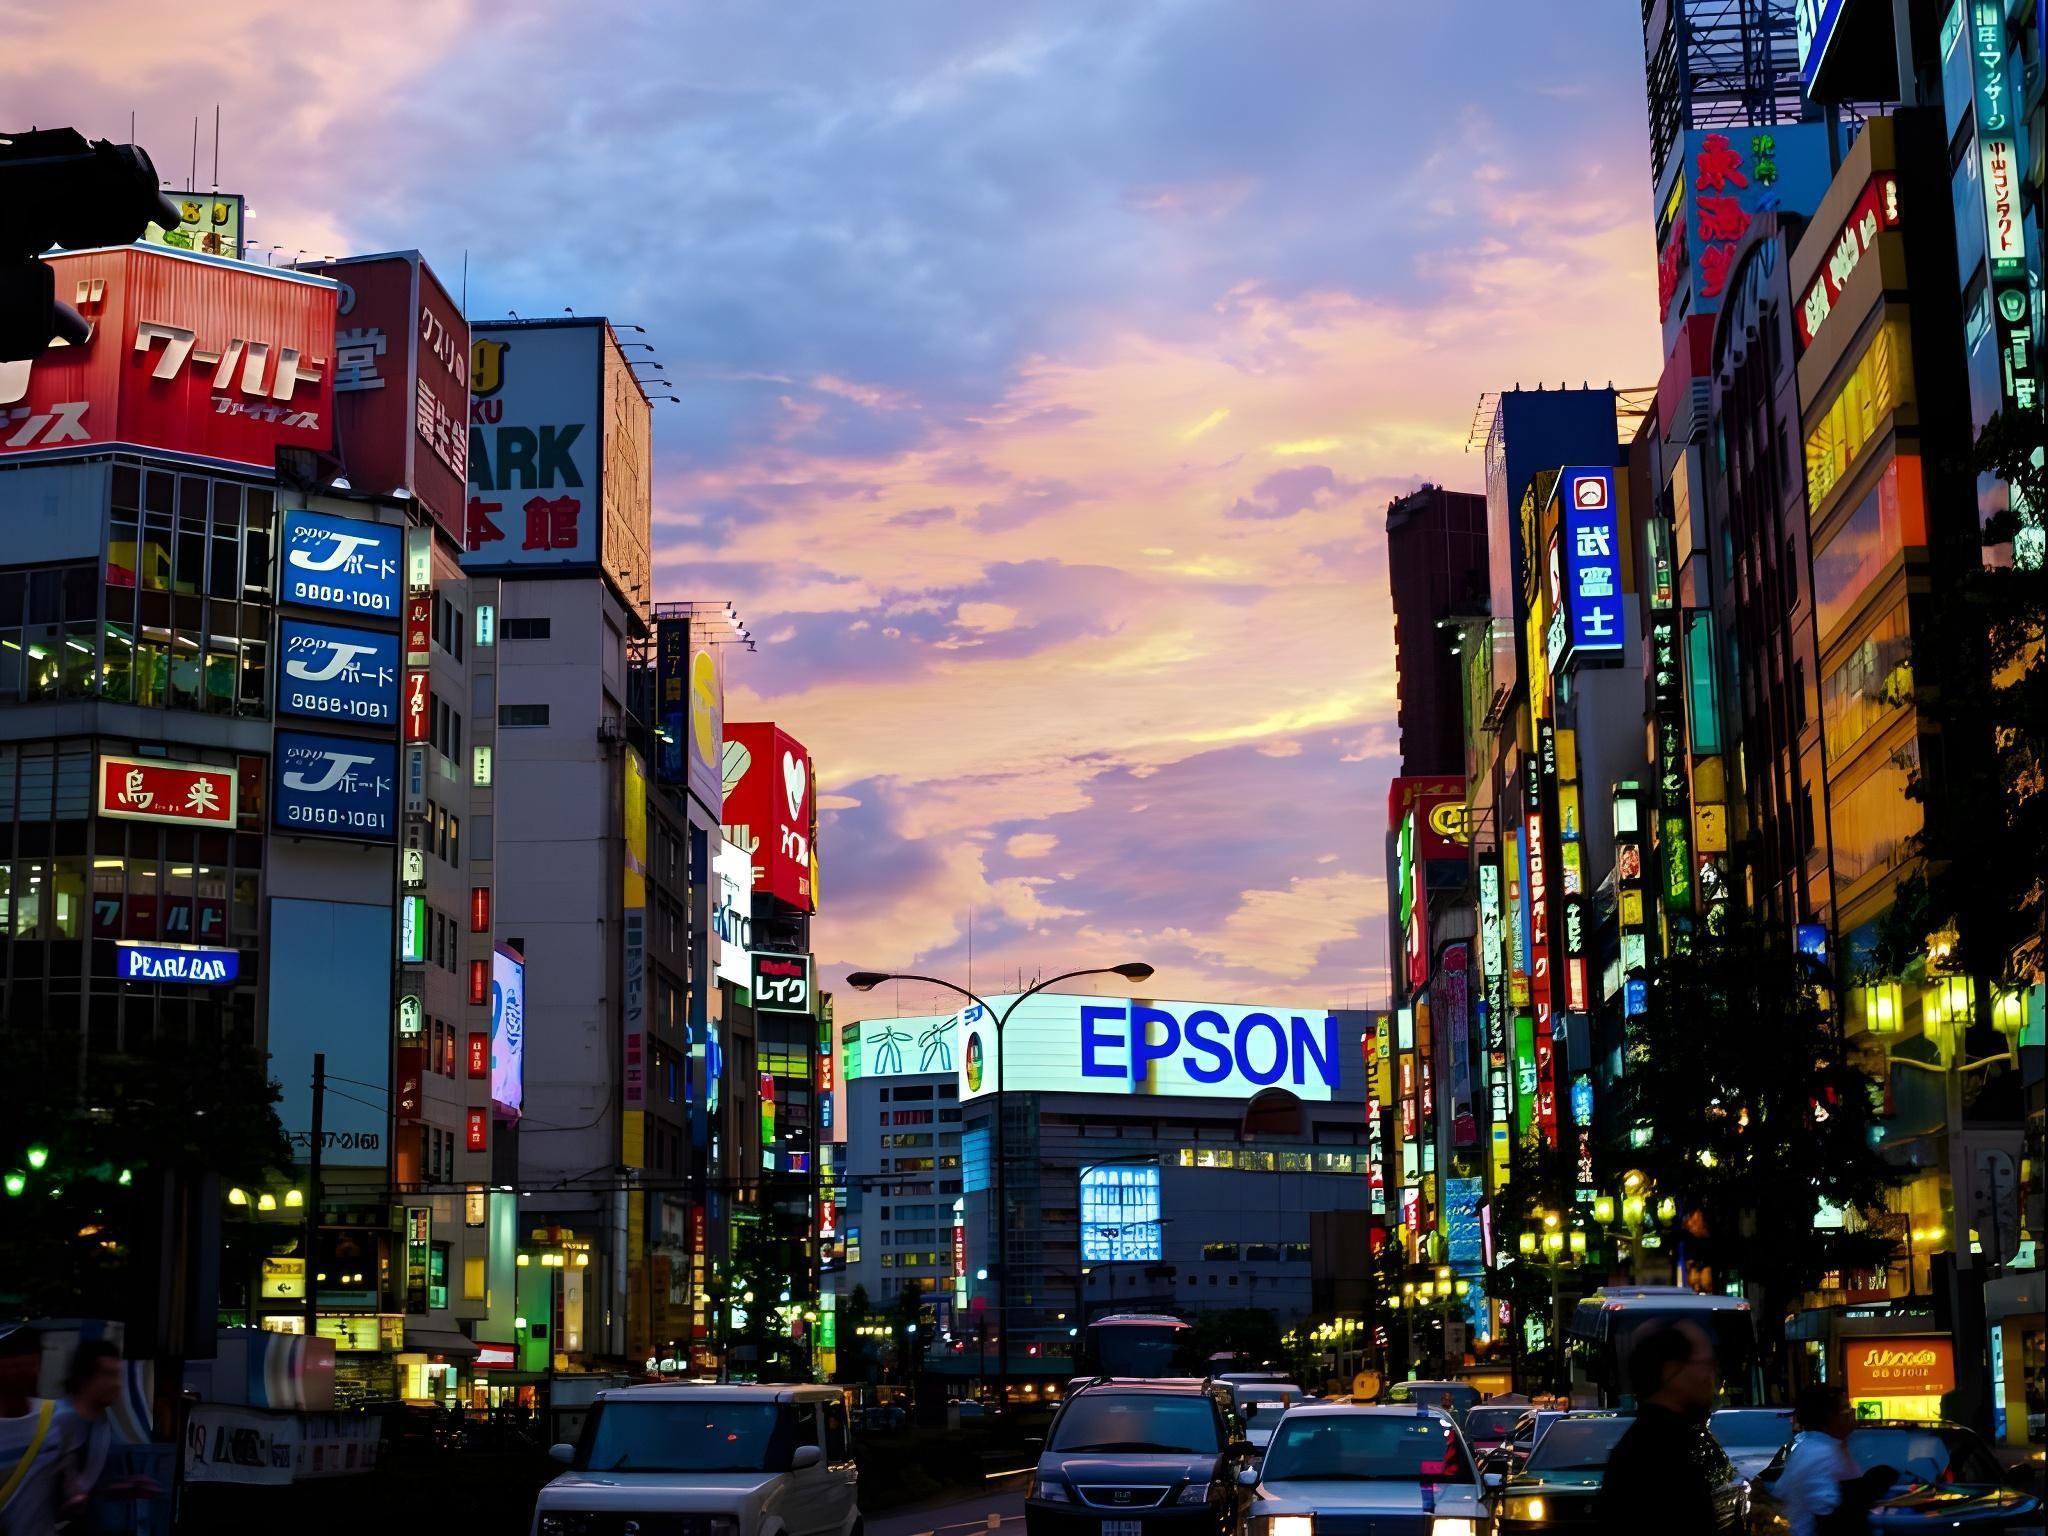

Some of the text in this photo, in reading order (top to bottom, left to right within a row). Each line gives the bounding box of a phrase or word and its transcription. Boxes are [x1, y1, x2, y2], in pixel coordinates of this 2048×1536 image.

[756, 974, 806, 1004] レイク
[1080, 1005, 1341, 1090] EPSON
